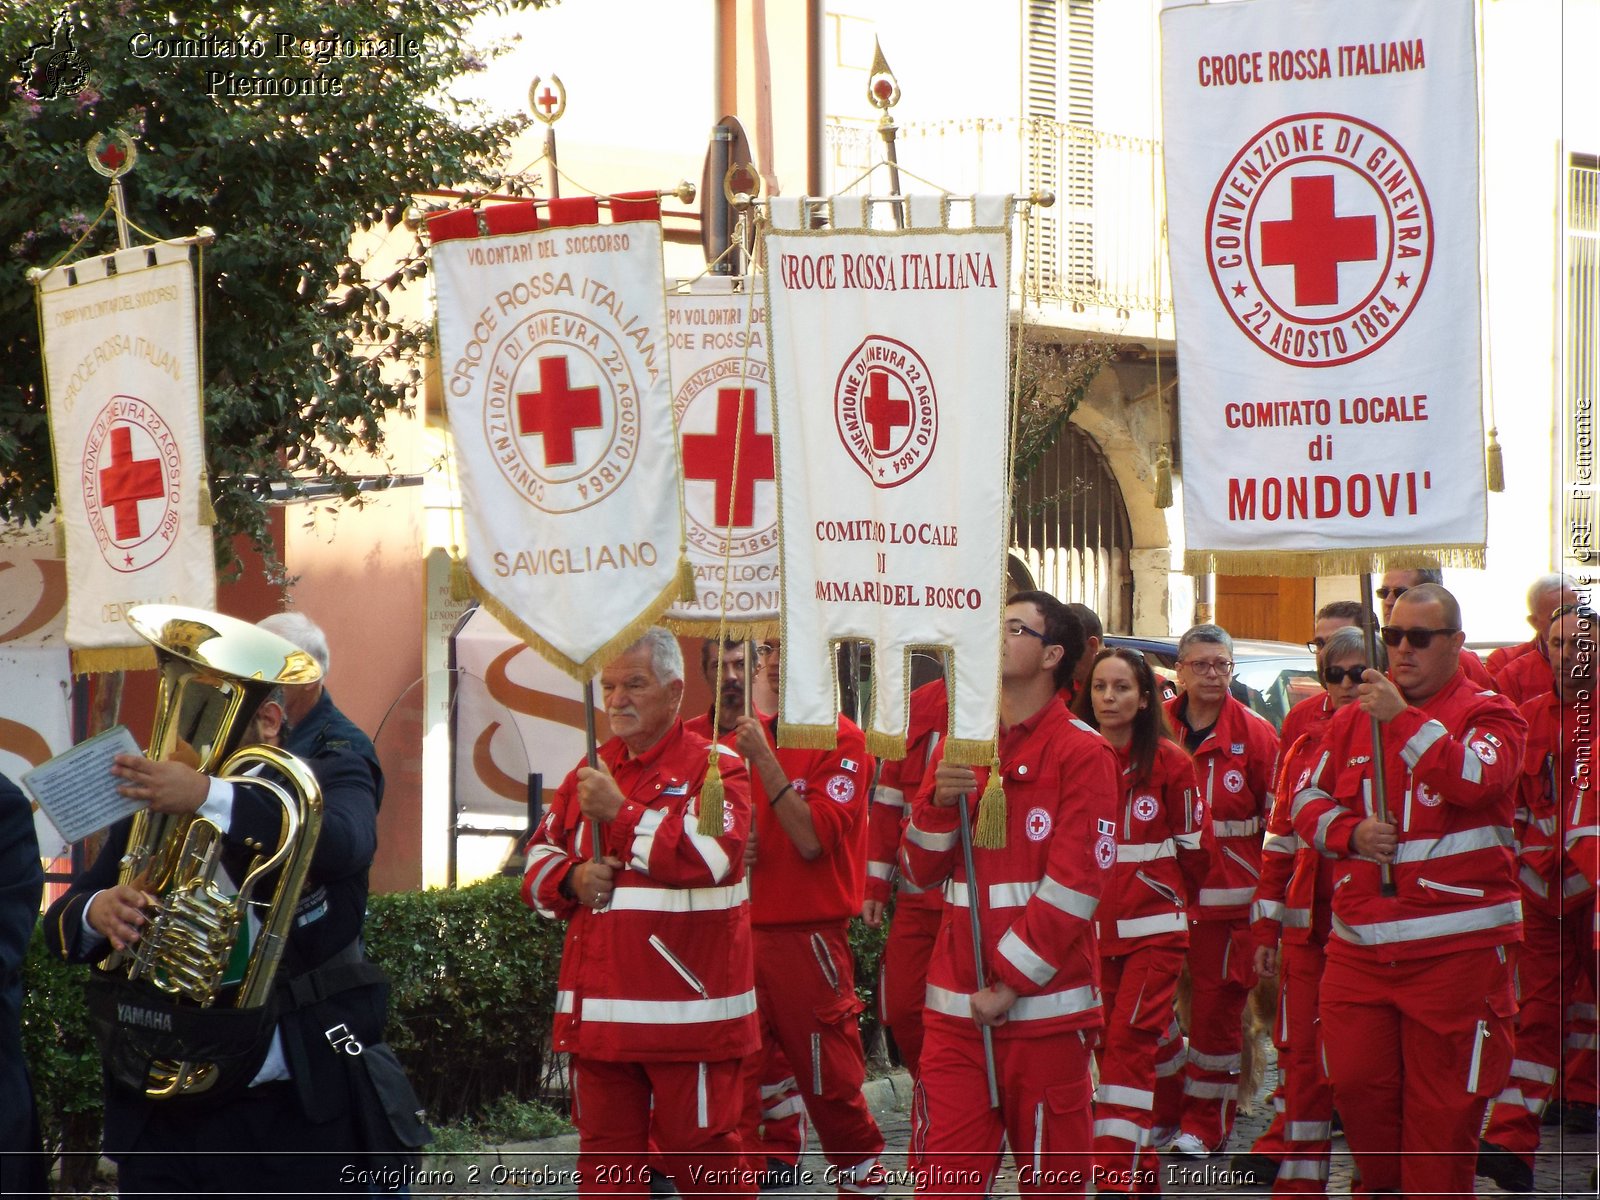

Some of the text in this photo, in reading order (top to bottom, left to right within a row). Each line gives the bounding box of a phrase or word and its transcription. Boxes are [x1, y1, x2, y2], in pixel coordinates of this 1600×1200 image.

[1198, 38, 1426, 87] CROCE ROSSA ITALIANA
[1215, 124, 1422, 269] CONVENZIONE DI GINEVRA
[538, 240, 559, 260] DEL
[565, 233, 630, 255] SOCCORSO
[781, 252, 998, 292] CROCE ROSSA ITALIANA
[750, 307, 767, 324] DE
[1242, 294, 1401, 358] 22 AGOSTO 1864
[449, 306, 498, 398] CROCE
[495, 272, 574, 317] ROSSA
[504, 339, 524, 361] DI
[527, 315, 600, 351] GINEVRA
[702, 331, 763, 350] ROSSA
[602, 350, 625, 377] 22
[905, 364, 922, 384] 22
[147, 413, 161, 434] 22
[615, 383, 636, 461] AGOSTO
[915, 384, 933, 446] AGOSTO
[1225, 394, 1429, 429] COMITATO LOCALE
[892, 446, 921, 475] 1864
[1308, 434, 1333, 461] di
[158, 431, 180, 504] AGOSTO
[577, 461, 622, 500] 1864
[1227, 471, 1431, 521] MONDOVI'
[160, 508, 179, 541] 1864
[889, 522, 959, 547] LOCALE
[493, 541, 658, 578] SAVIGLIANO
[882, 584, 921, 607] DEL
[925, 586, 982, 611] BOSCO
[117, 1003, 172, 1031] YAMAHA
